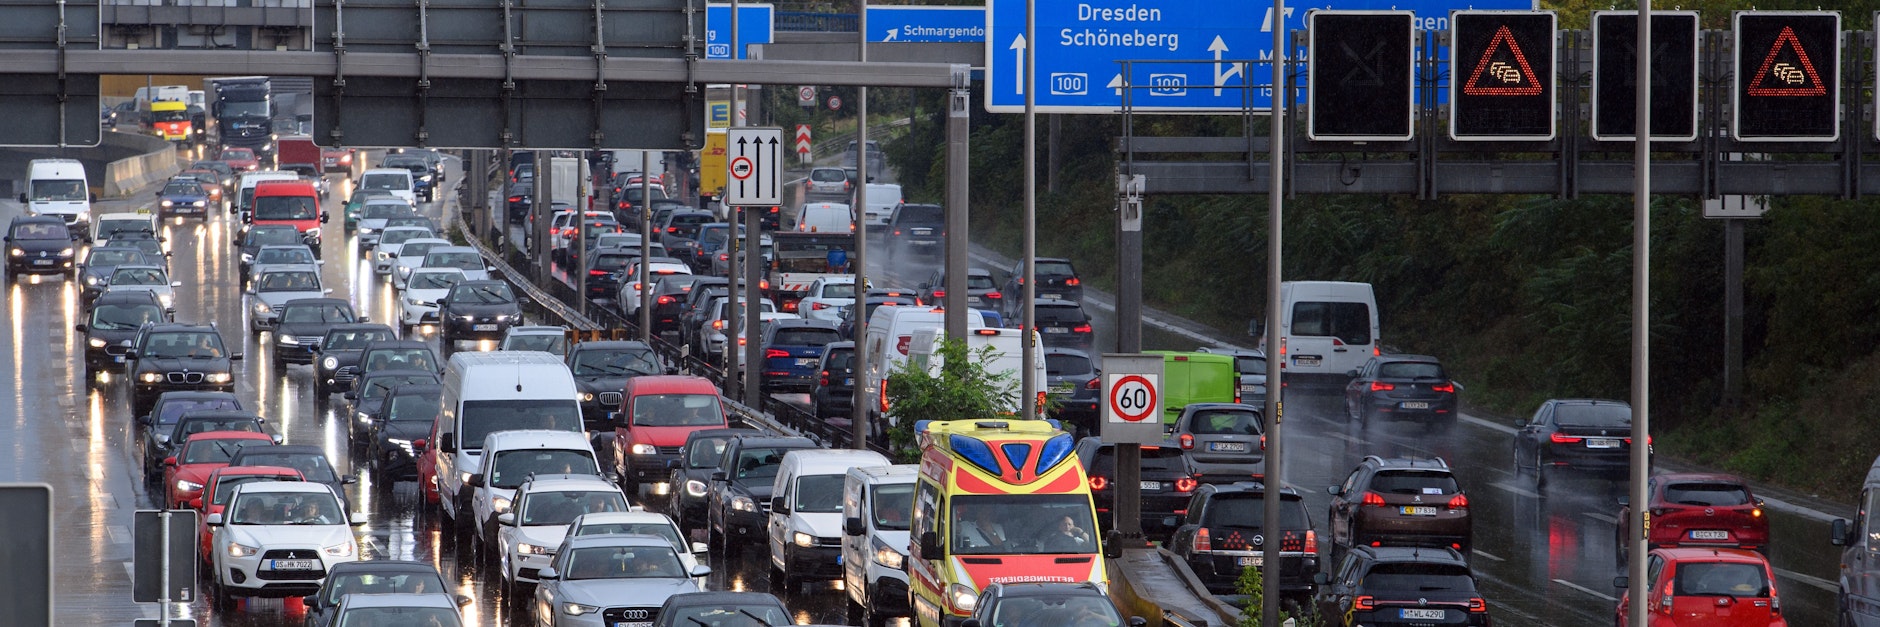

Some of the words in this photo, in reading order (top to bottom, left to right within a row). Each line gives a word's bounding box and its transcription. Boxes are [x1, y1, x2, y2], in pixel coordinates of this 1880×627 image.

[1078, 3, 1161, 21] Dresden
[1060, 28, 1179, 50] Schöneberg
[711, 46, 726, 55] 100
[1057, 77, 1081, 91] 100
[1156, 78, 1180, 92] 100
[1120, 388, 1146, 409] 60
[1425, 610, 1444, 618] 4290
